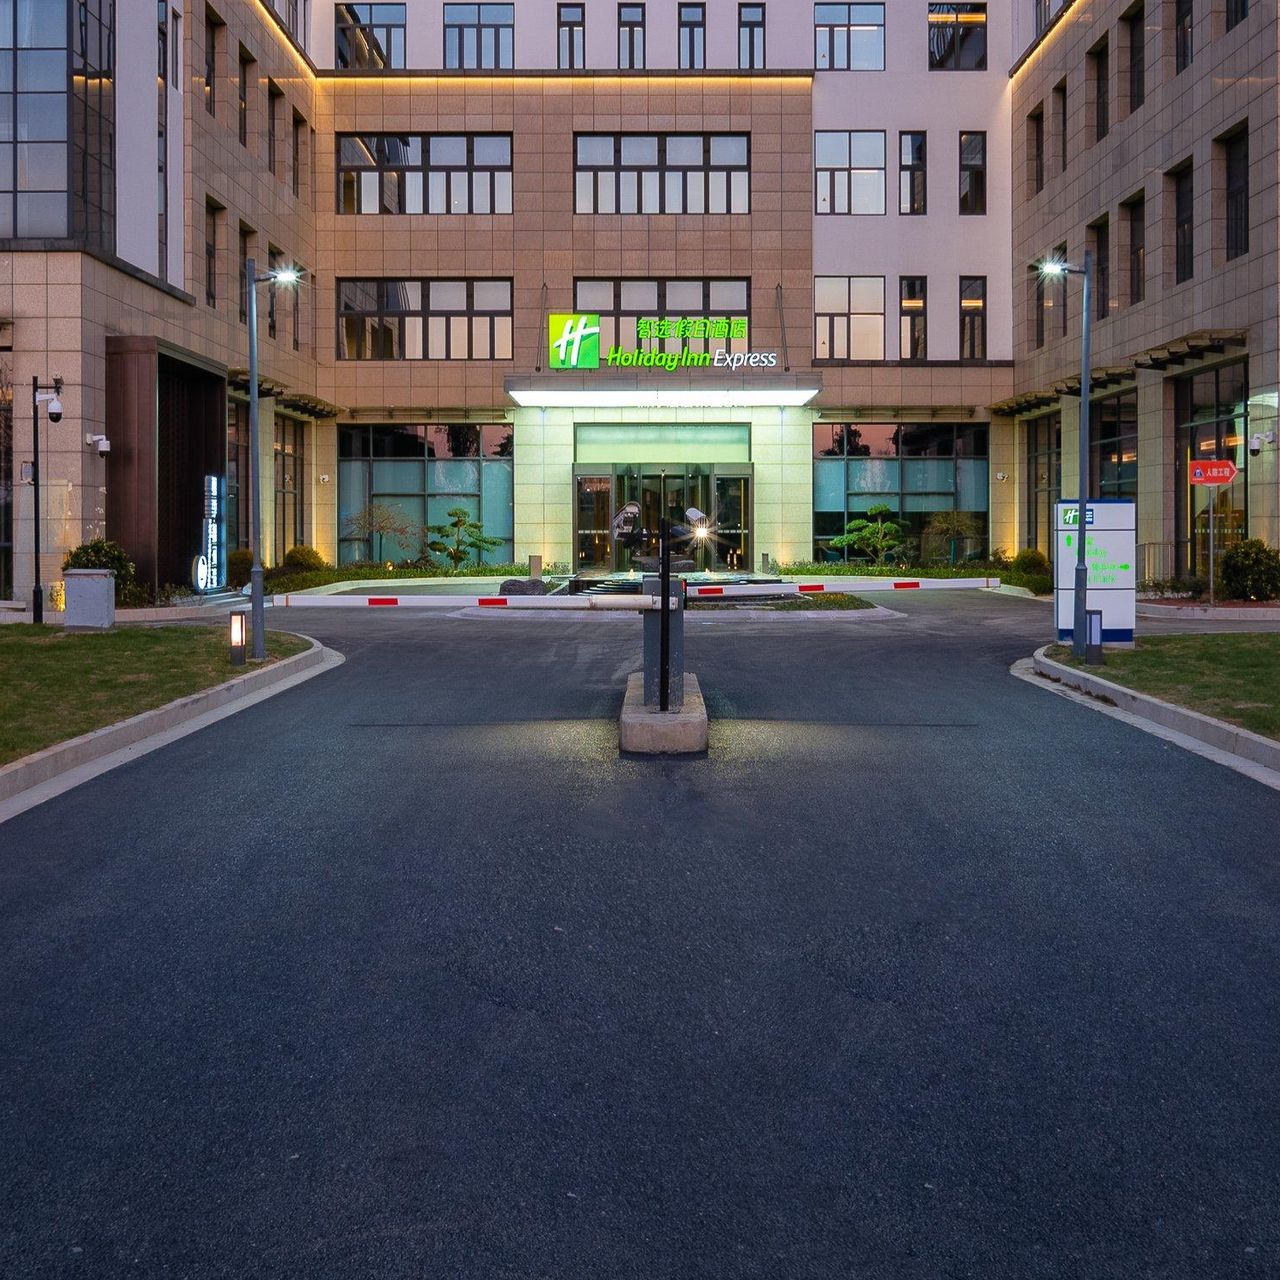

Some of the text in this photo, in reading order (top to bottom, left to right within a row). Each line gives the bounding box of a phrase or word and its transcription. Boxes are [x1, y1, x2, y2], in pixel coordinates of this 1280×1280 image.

[637, 319, 746, 338] 智选假日酒店
[606, 346, 777, 371] Holiday Inn Express
